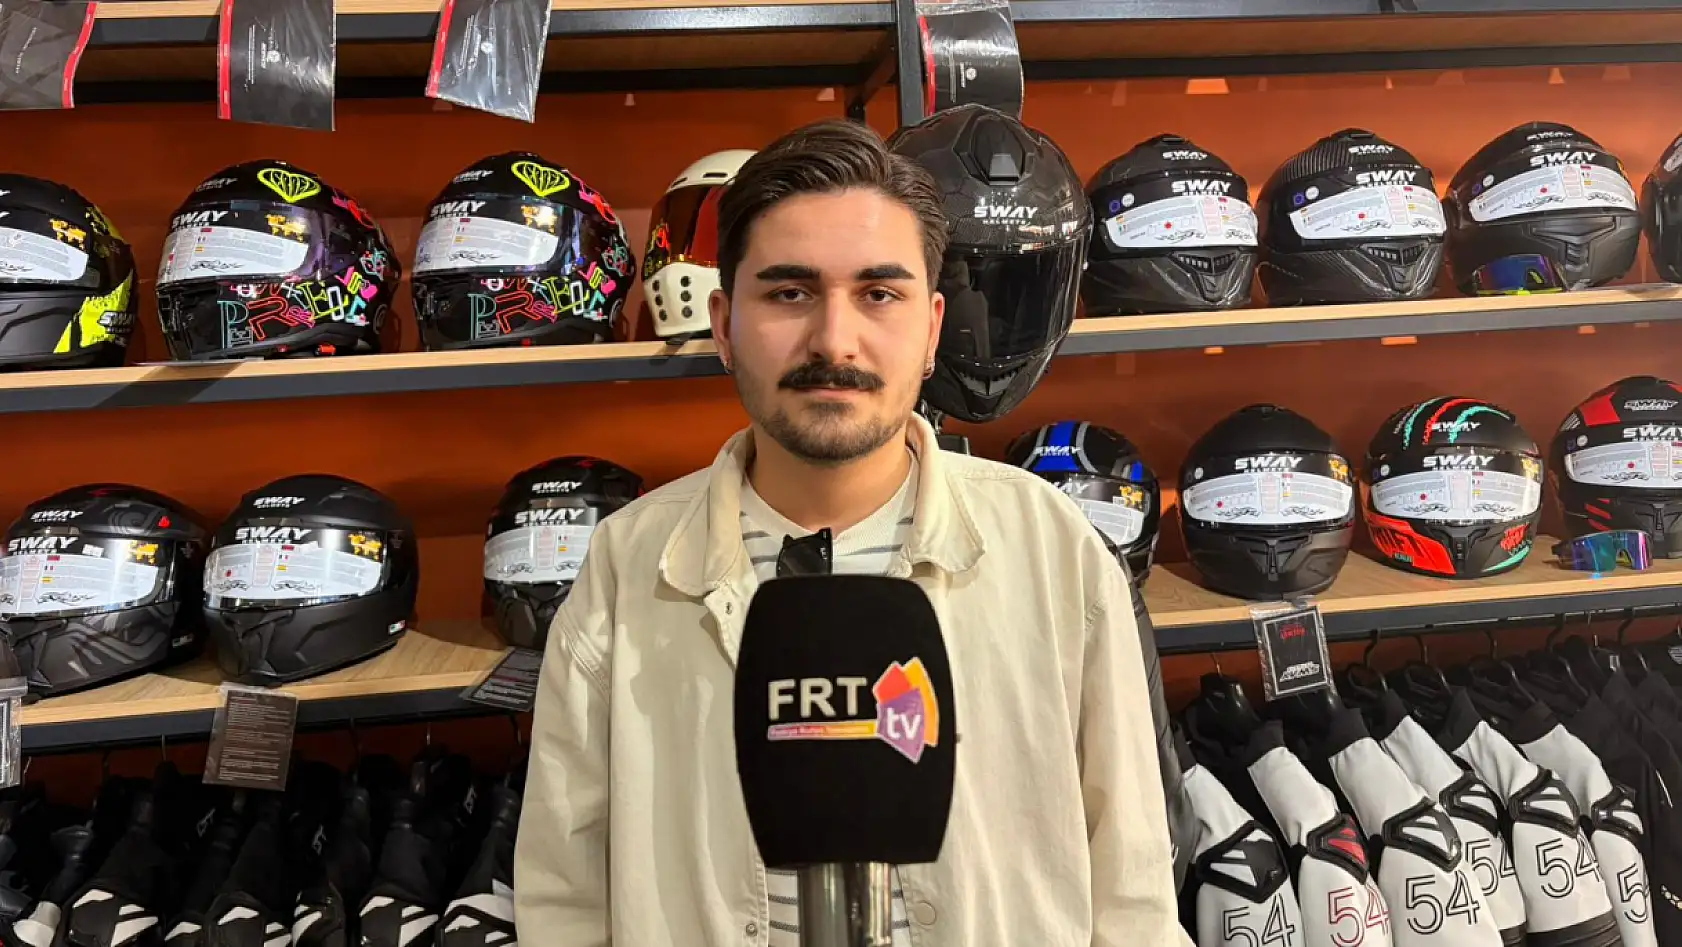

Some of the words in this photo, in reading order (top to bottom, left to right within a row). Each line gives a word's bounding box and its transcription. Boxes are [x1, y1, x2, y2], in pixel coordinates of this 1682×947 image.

[1530, 151, 1597, 166] SWAY
[1355, 170, 1416, 184] SWAY
[1171, 179, 1232, 192] SWAY
[430, 200, 486, 217] SWAY
[974, 206, 1038, 218] SWAY
[172, 210, 229, 228] SWAY
[1623, 427, 1682, 438] SWA
[1235, 456, 1303, 470] SWAY
[1423, 455, 1494, 467] SWAY
[514, 508, 585, 524] SWAY
[235, 526, 312, 540] SWAY
[8, 537, 79, 552] SWAY
[768, 676, 868, 720] FRT
[886, 707, 922, 740] tv
[1536, 838, 1601, 898] 54
[1406, 870, 1480, 935] 54
[1223, 892, 1295, 947] 54
[1328, 883, 1389, 947] 54
